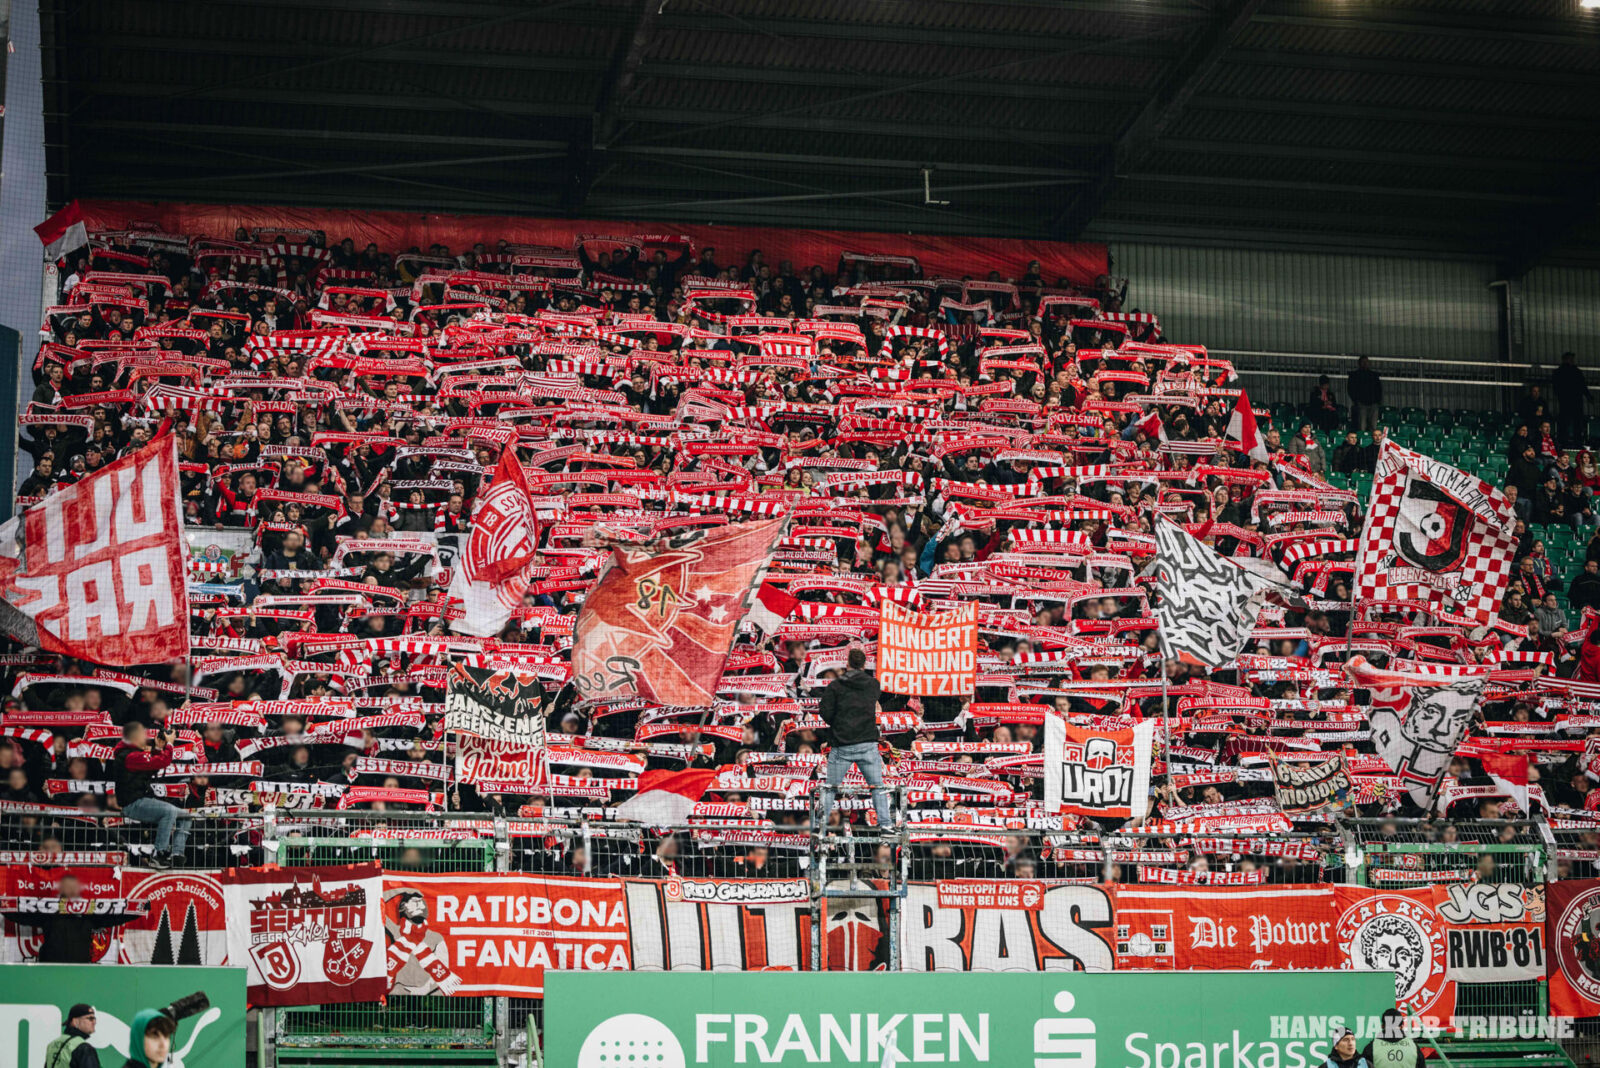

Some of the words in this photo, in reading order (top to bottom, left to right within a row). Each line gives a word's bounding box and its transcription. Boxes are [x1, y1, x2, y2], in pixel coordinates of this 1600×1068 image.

[882, 602, 975, 628] ACHTZEHN
[881, 625, 976, 651] HUNDERT
[881, 651, 975, 672] NEUNUND
[880, 671, 975, 695] ACHTZIG
[17, 879, 35, 891] Die
[682, 880, 718, 900] RED
[719, 879, 806, 901] GENERATION
[939, 882, 995, 896] CHRISTOPH
[999, 881, 1020, 896] FÜR
[435, 894, 627, 928] RATISBONA
[940, 894, 974, 907] IMMER
[977, 894, 995, 907] BEI
[998, 894, 1020, 907] UNS
[1438, 883, 1527, 924] JGS
[337, 927, 363, 939] 2019
[1187, 914, 1239, 950] Die
[1247, 913, 1332, 954] Power
[456, 939, 630, 971] FANATICA
[695, 1013, 991, 1064] FRANKEN
[1387, 1049, 1404, 1062] 60
